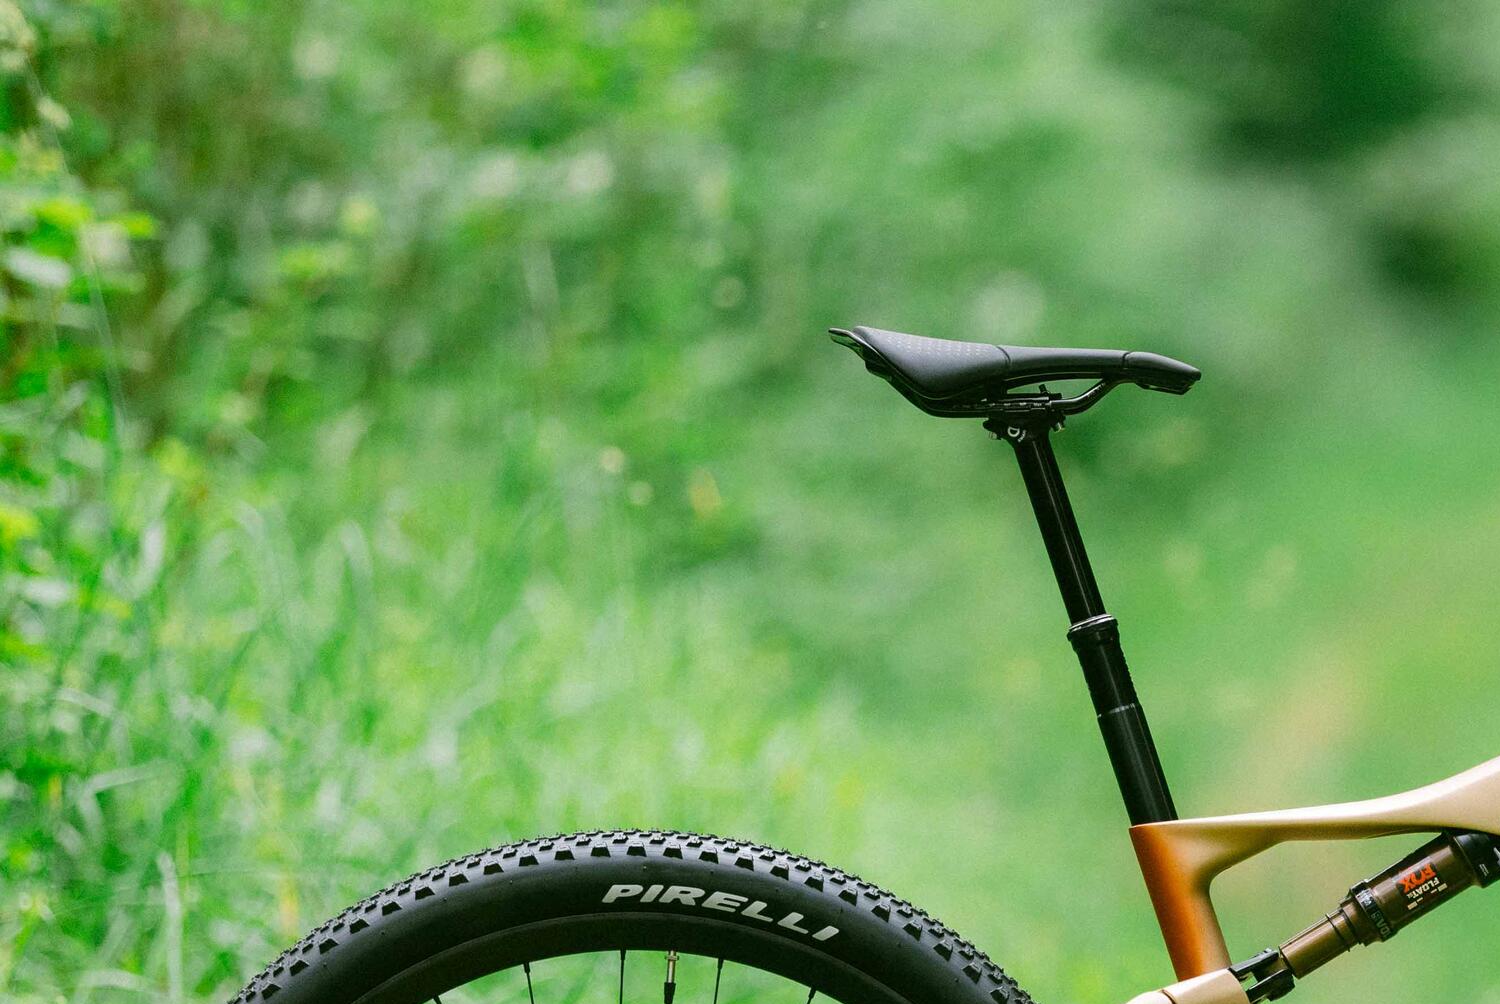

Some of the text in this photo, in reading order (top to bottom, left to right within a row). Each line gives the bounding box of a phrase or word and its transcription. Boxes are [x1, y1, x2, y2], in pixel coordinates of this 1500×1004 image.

[1398, 863, 1437, 893] FOX
[1410, 876, 1440, 899] FLOAT
[601, 884, 840, 942] PIRELLI
